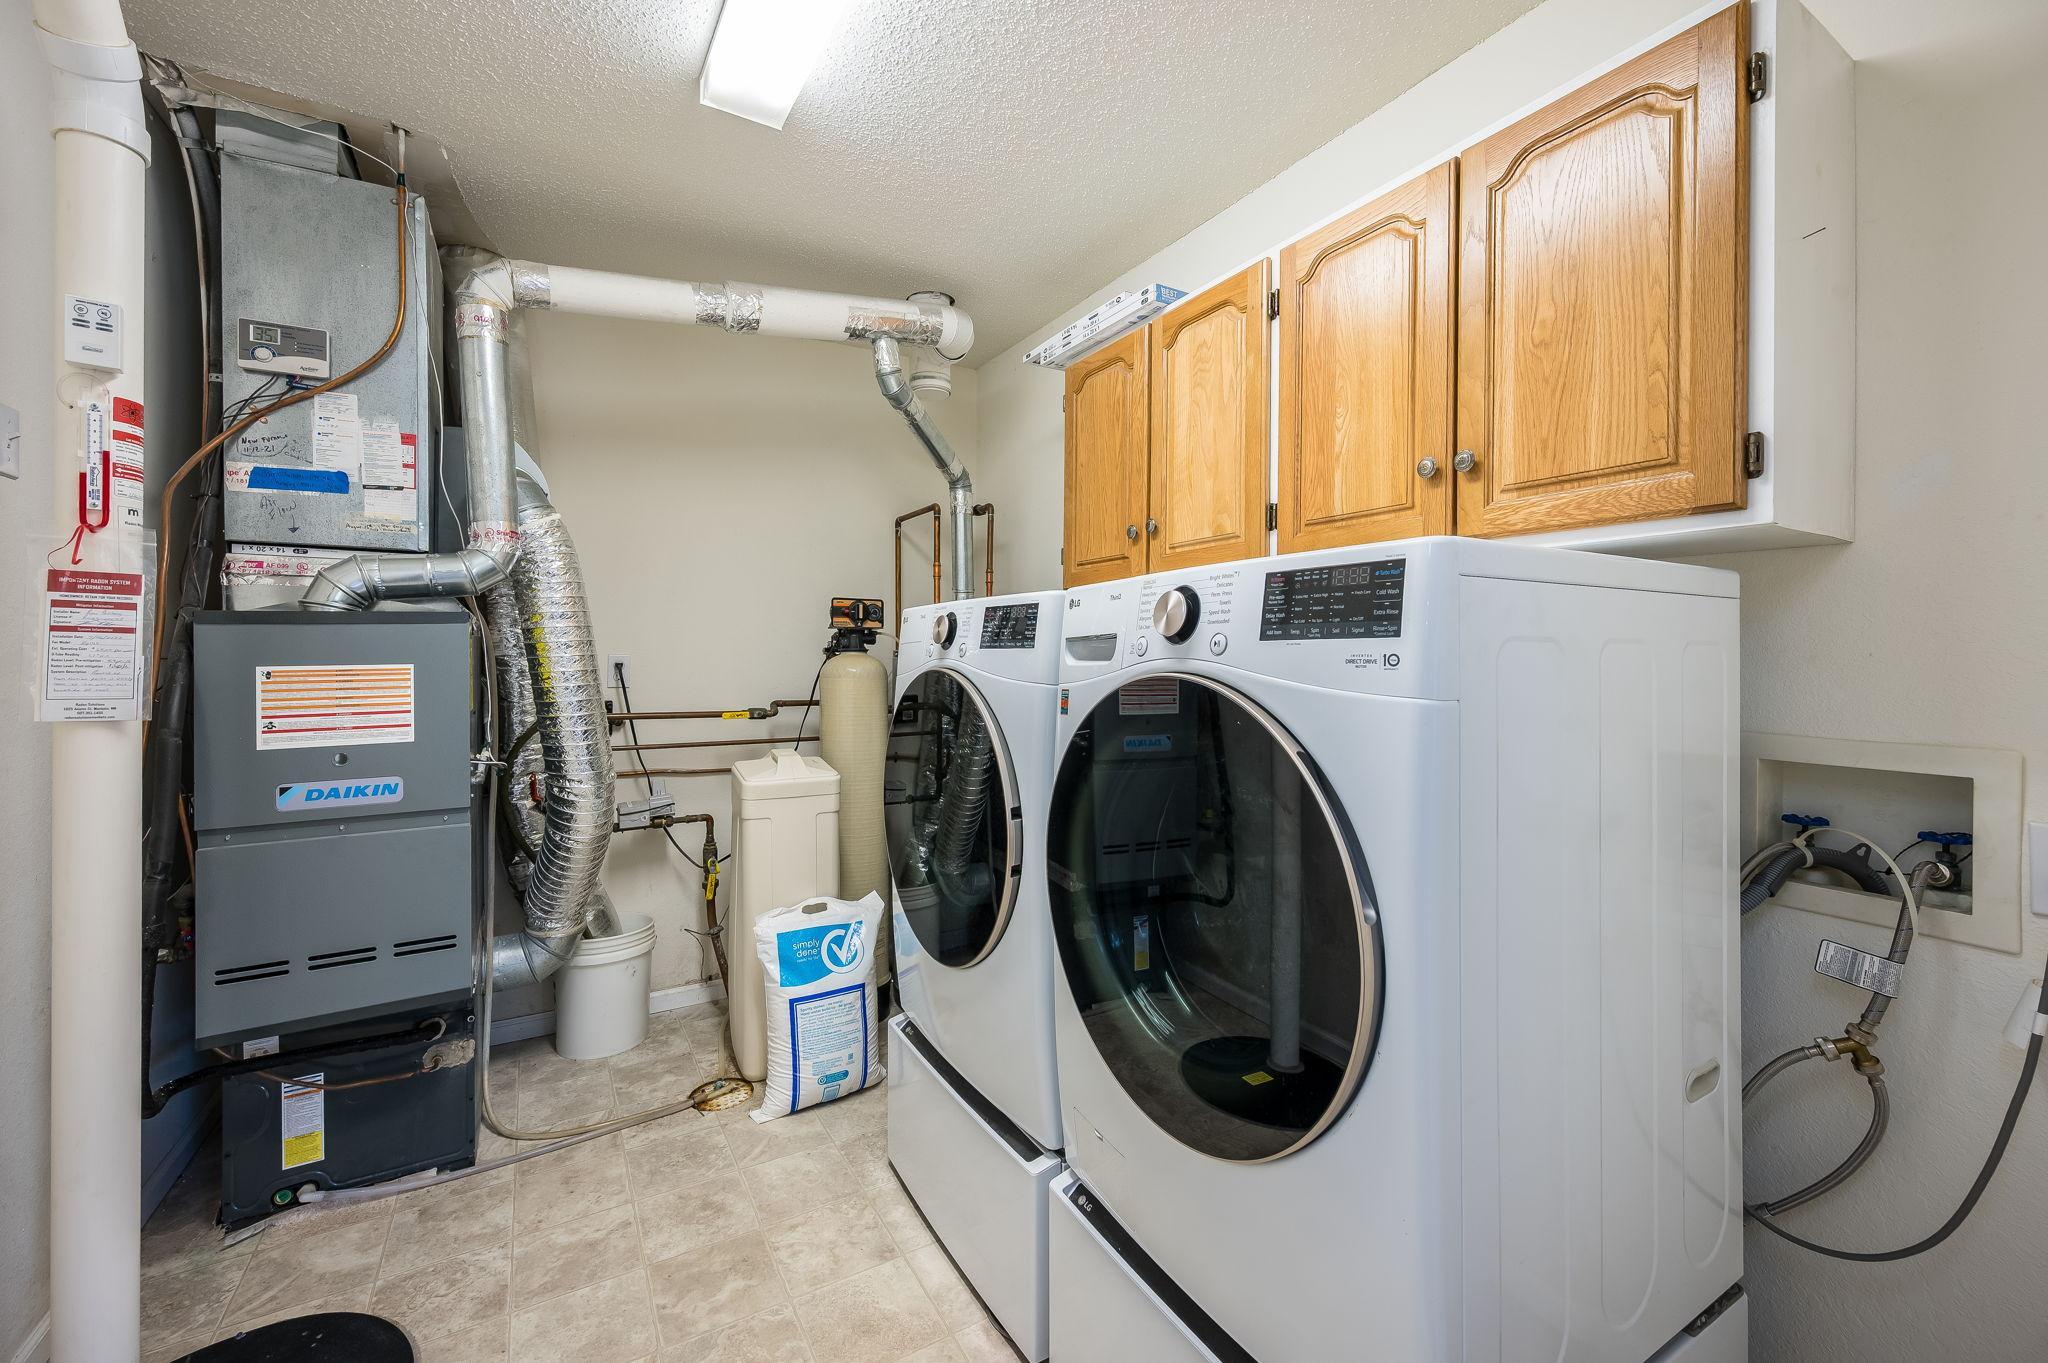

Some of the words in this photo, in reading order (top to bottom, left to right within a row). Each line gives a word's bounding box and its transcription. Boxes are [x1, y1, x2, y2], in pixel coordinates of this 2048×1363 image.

[1161, 286, 1178, 298] BEST
[1383, 654, 1400, 667] 10
[304, 783, 399, 802] DAIKIN
[793, 939, 820, 950] simply
[797, 949, 817, 957] done
